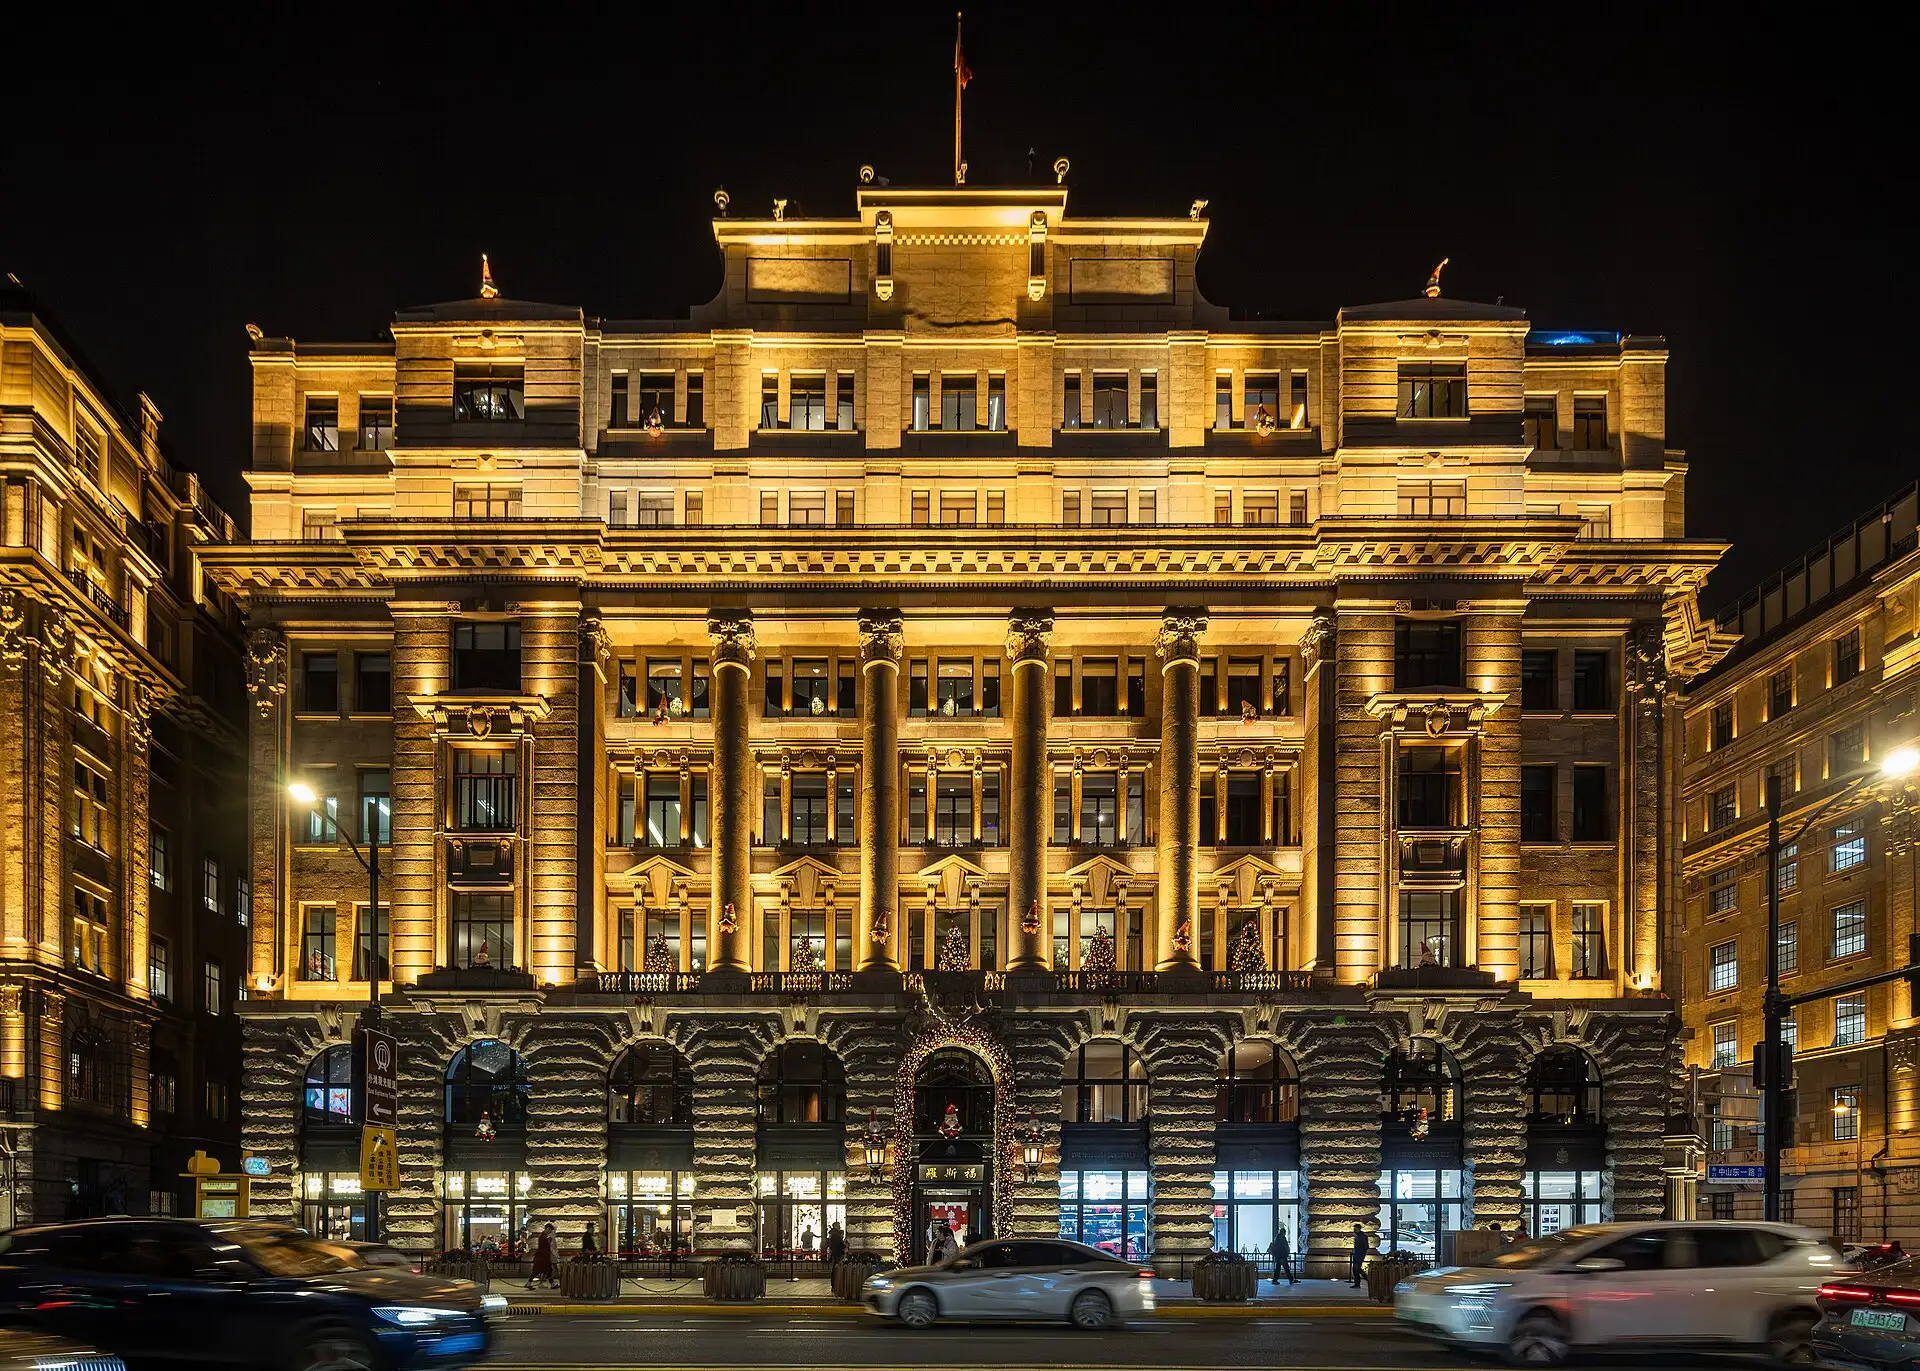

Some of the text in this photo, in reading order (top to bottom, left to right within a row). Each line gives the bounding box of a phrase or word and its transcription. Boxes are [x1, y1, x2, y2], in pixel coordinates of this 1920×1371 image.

[1718, 1167, 1755, 1177] 中山东一路
